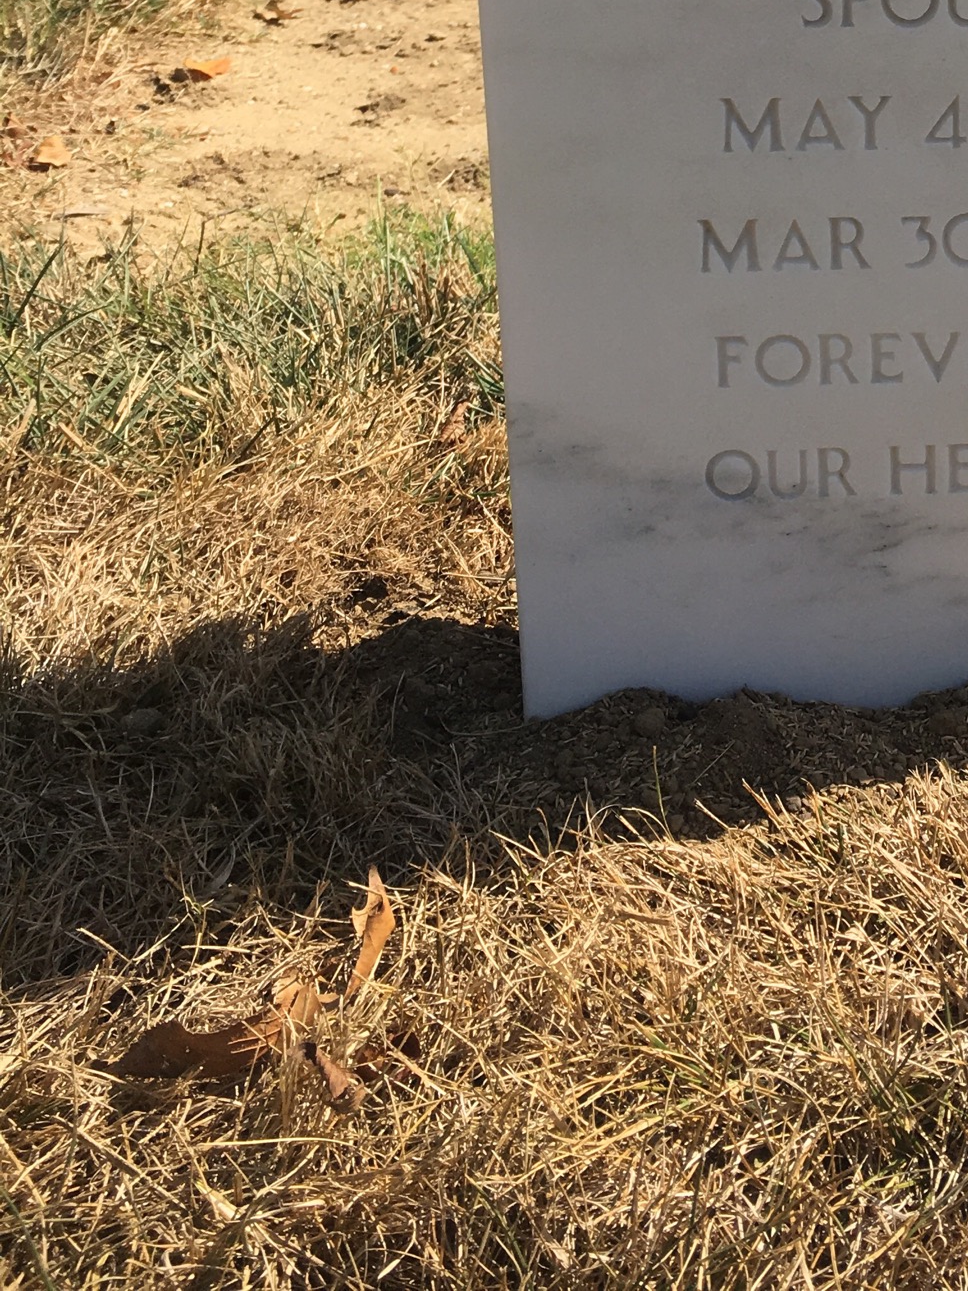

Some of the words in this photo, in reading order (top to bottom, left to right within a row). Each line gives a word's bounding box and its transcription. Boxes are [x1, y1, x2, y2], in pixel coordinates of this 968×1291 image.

[719, 94, 893, 153] MAY
[924, 94, 968, 150] 4
[697, 216, 872, 274] MAR
[704, 447, 858, 502] OUR
